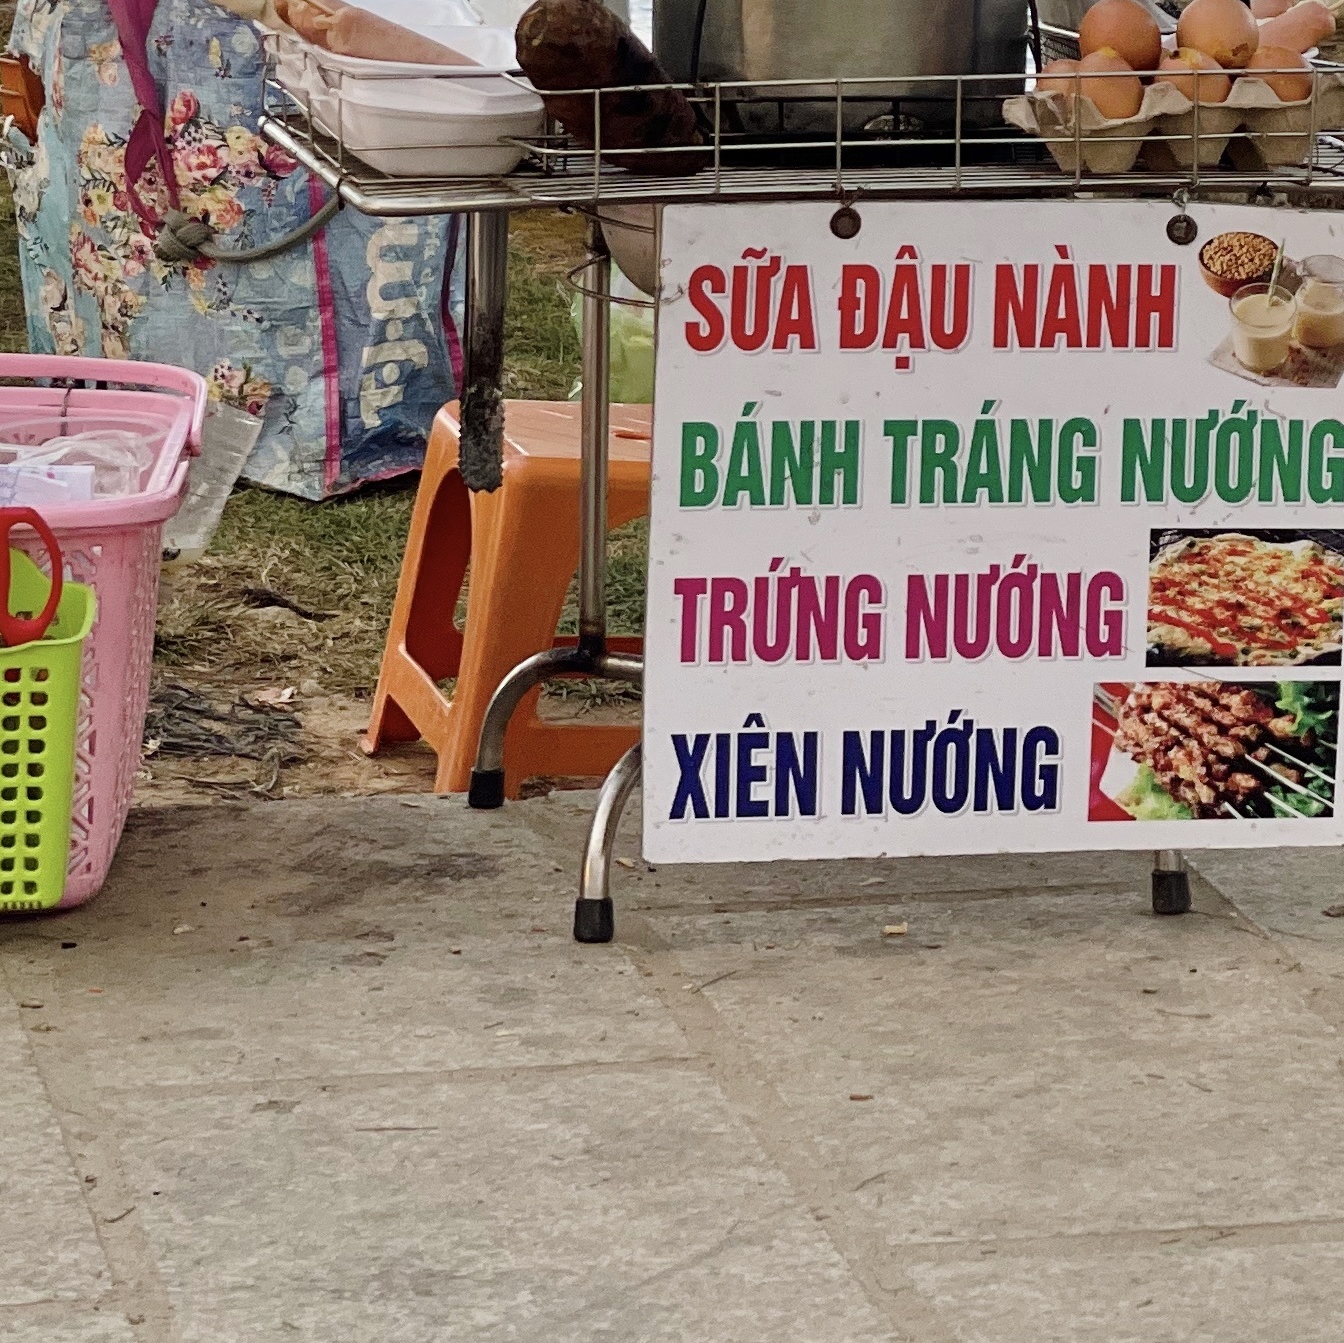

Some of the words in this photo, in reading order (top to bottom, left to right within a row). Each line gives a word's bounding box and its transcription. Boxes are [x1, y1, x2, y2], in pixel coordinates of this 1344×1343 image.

[685, 248, 815, 351] SỮA
[838, 245, 970, 369] ĐẬU
[993, 245, 1176, 348] NÀNH
[680, 402, 859, 507] BÁNH
[884, 400, 1096, 504] TRÁNG
[674, 557, 882, 662] TRỨNG
[905, 554, 1123, 659] NƯỚNG
[669, 713, 817, 820] XIÊN
[841, 709, 1058, 815] NƯỚNG
